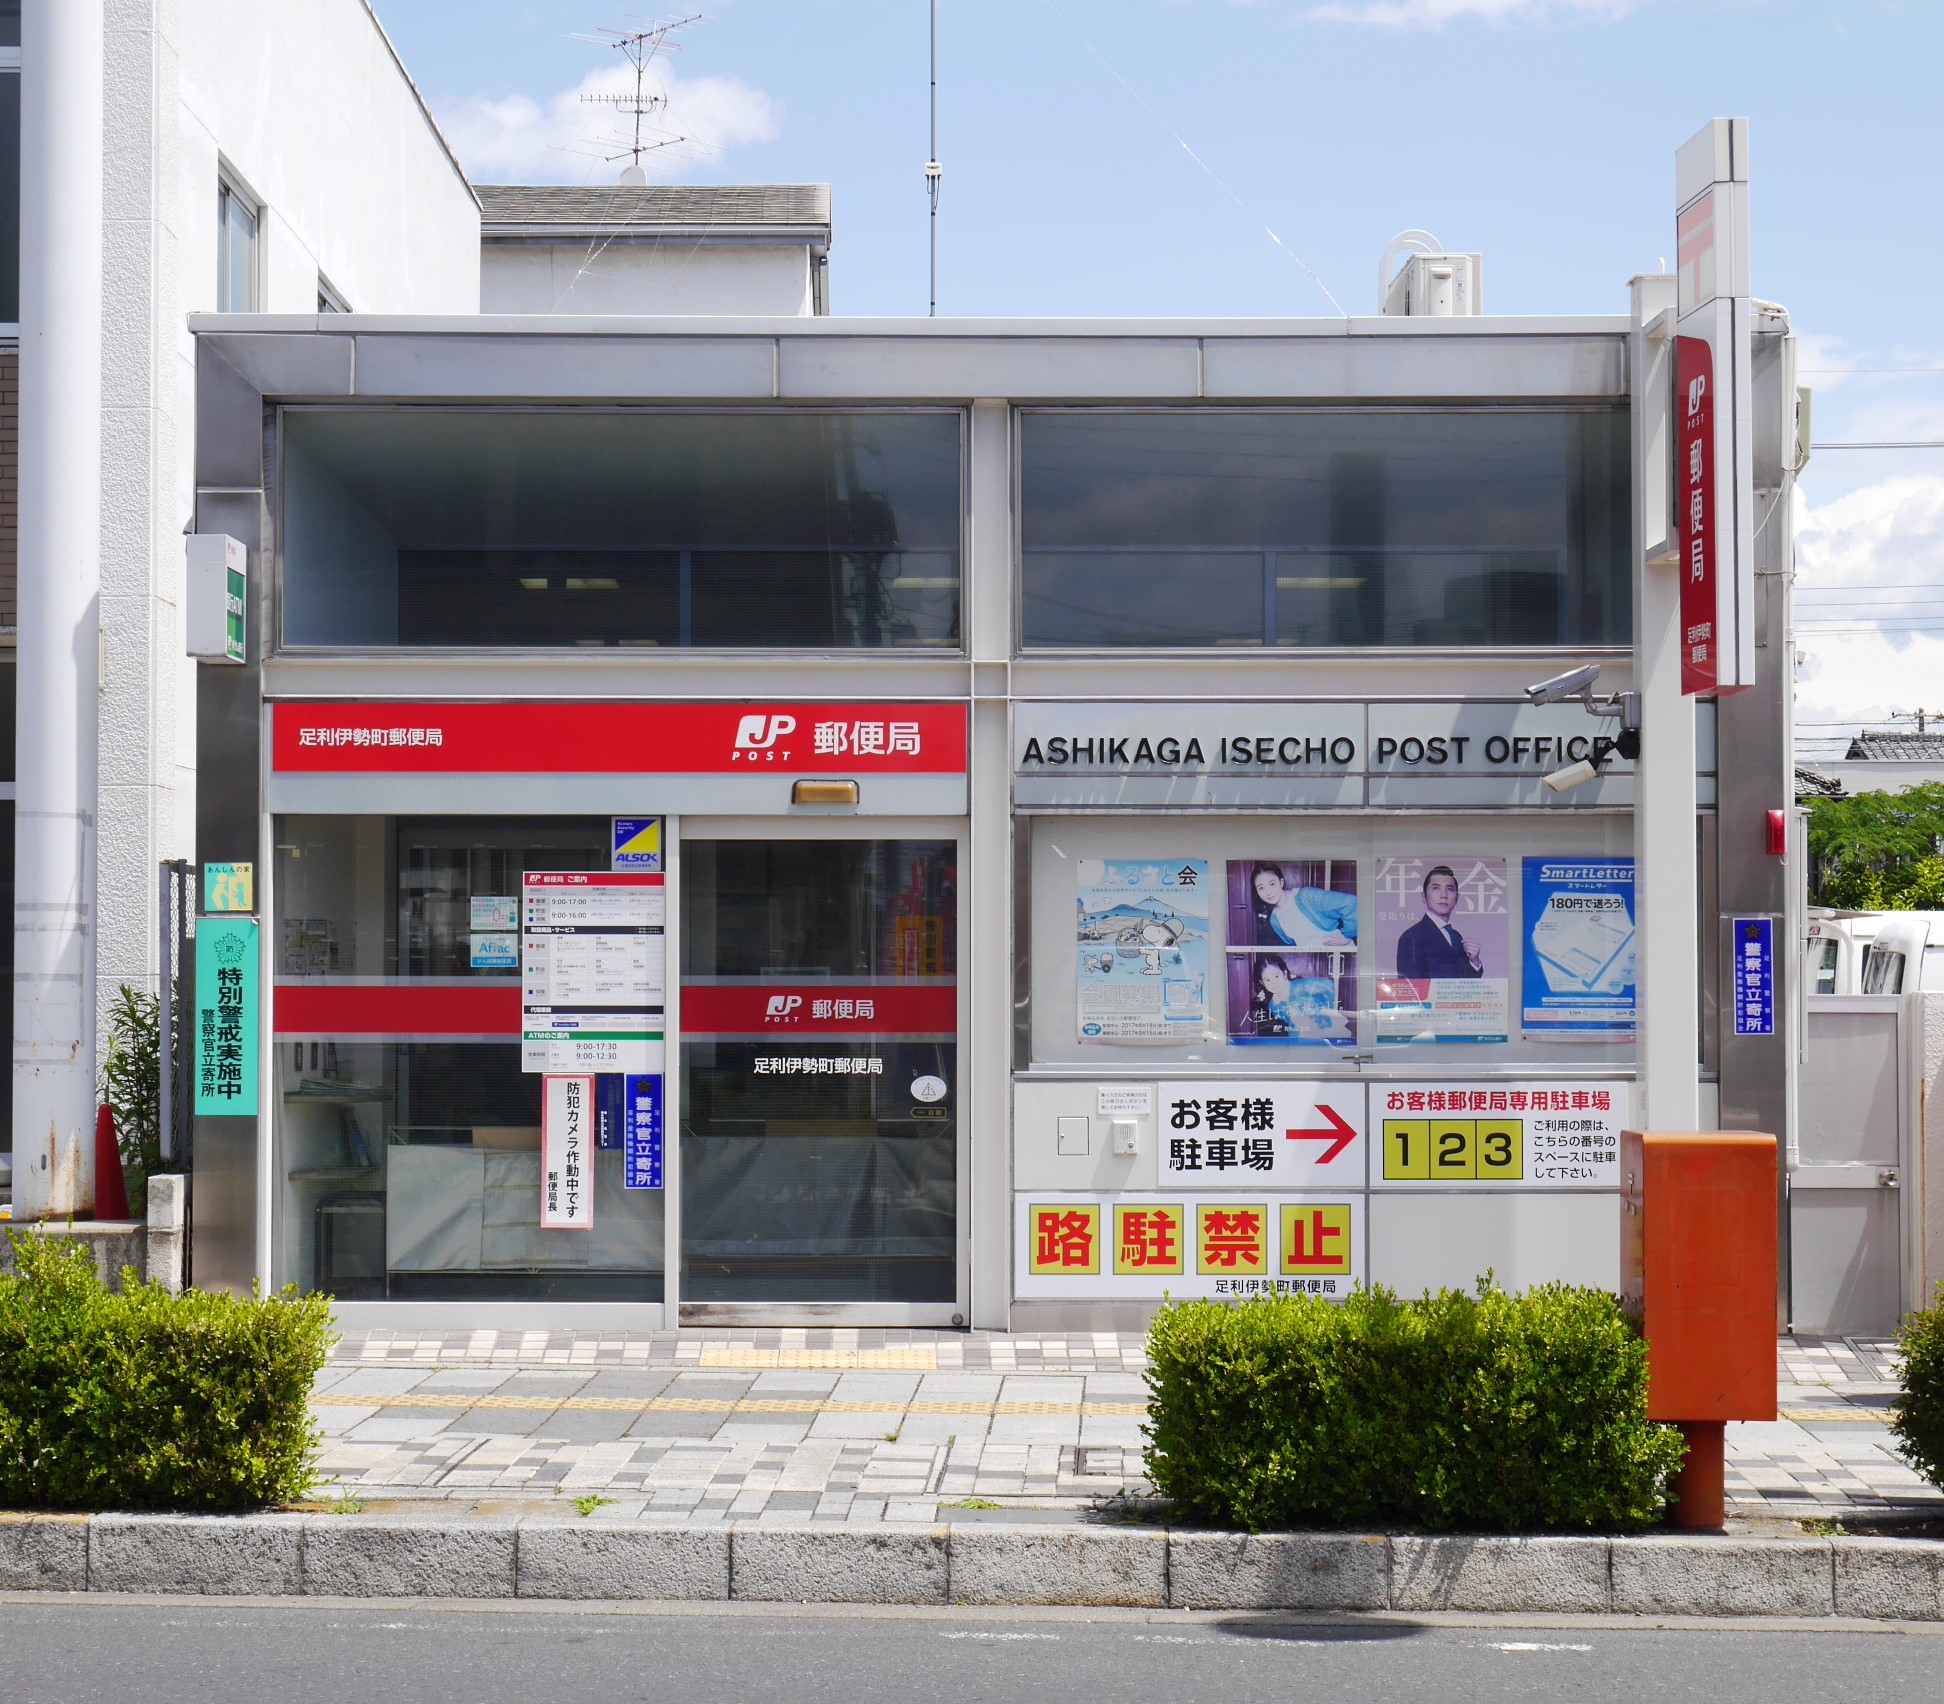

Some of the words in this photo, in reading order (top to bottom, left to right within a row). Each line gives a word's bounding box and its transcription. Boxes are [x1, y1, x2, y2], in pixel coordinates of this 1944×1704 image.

[1687, 412, 1705, 431] POST
[1689, 437, 1704, 584] 郵便局
[1692, 644, 1707, 663] 郵便局
[298, 728, 443, 747] 足利伊勢町郵便局
[813, 721, 921, 756] 郵便局
[731, 751, 791, 761] POST
[1022, 736, 1205, 765] ASHIKAGA
[1221, 736, 1356, 765] ISECHO
[1378, 736, 1470, 765] POST
[1484, 735, 1613, 764] OFFICE
[615, 853, 657, 863] ALSOK
[207, 865, 251, 873] あんしんの家
[543, 875, 564, 883] 郵便局
[567, 875, 588, 883] ご案内
[1103, 864, 1198, 886] ふるさと会
[1540, 864, 1635, 879] SmartLetter
[1744, 942, 1762, 1032] 警察官立寄所
[812, 999, 875, 1020] 郵便局
[216, 967, 243, 1100] 特別警戒実施中
[201, 1008, 215, 1097] 警察官立寄所
[576, 1052, 617, 1060] 9:00-12:30
[753, 1057, 883, 1075] 足利伊勢町郵便局
[1387, 1090, 1611, 1111] お客様郵便局専用駐車場
[1170, 1098, 1275, 1132] お客様
[1534, 1119, 1611, 1132] ご利用の際は、
[566, 1082, 581, 1218] 防犯カメラ作動中です
[635, 1097, 652, 1186] 警察官立寄所
[1395, 1132, 1409, 1167] 1
[1438, 1132, 1466, 1167] 2
[1484, 1132, 1512, 1167] 3
[1534, 1135, 1616, 1147] こちらの番号の
[1169, 1138, 1275, 1171] 駐車場
[1534, 1151, 1617, 1163] スペースに駐車
[1535, 1167, 1600, 1179] して下さい。
[547, 1171, 558, 1212] 郵便局長
[1036, 1210, 1343, 1267] 路駐禁止
[1215, 1279, 1336, 1294] 足利伊勢町郵便局
